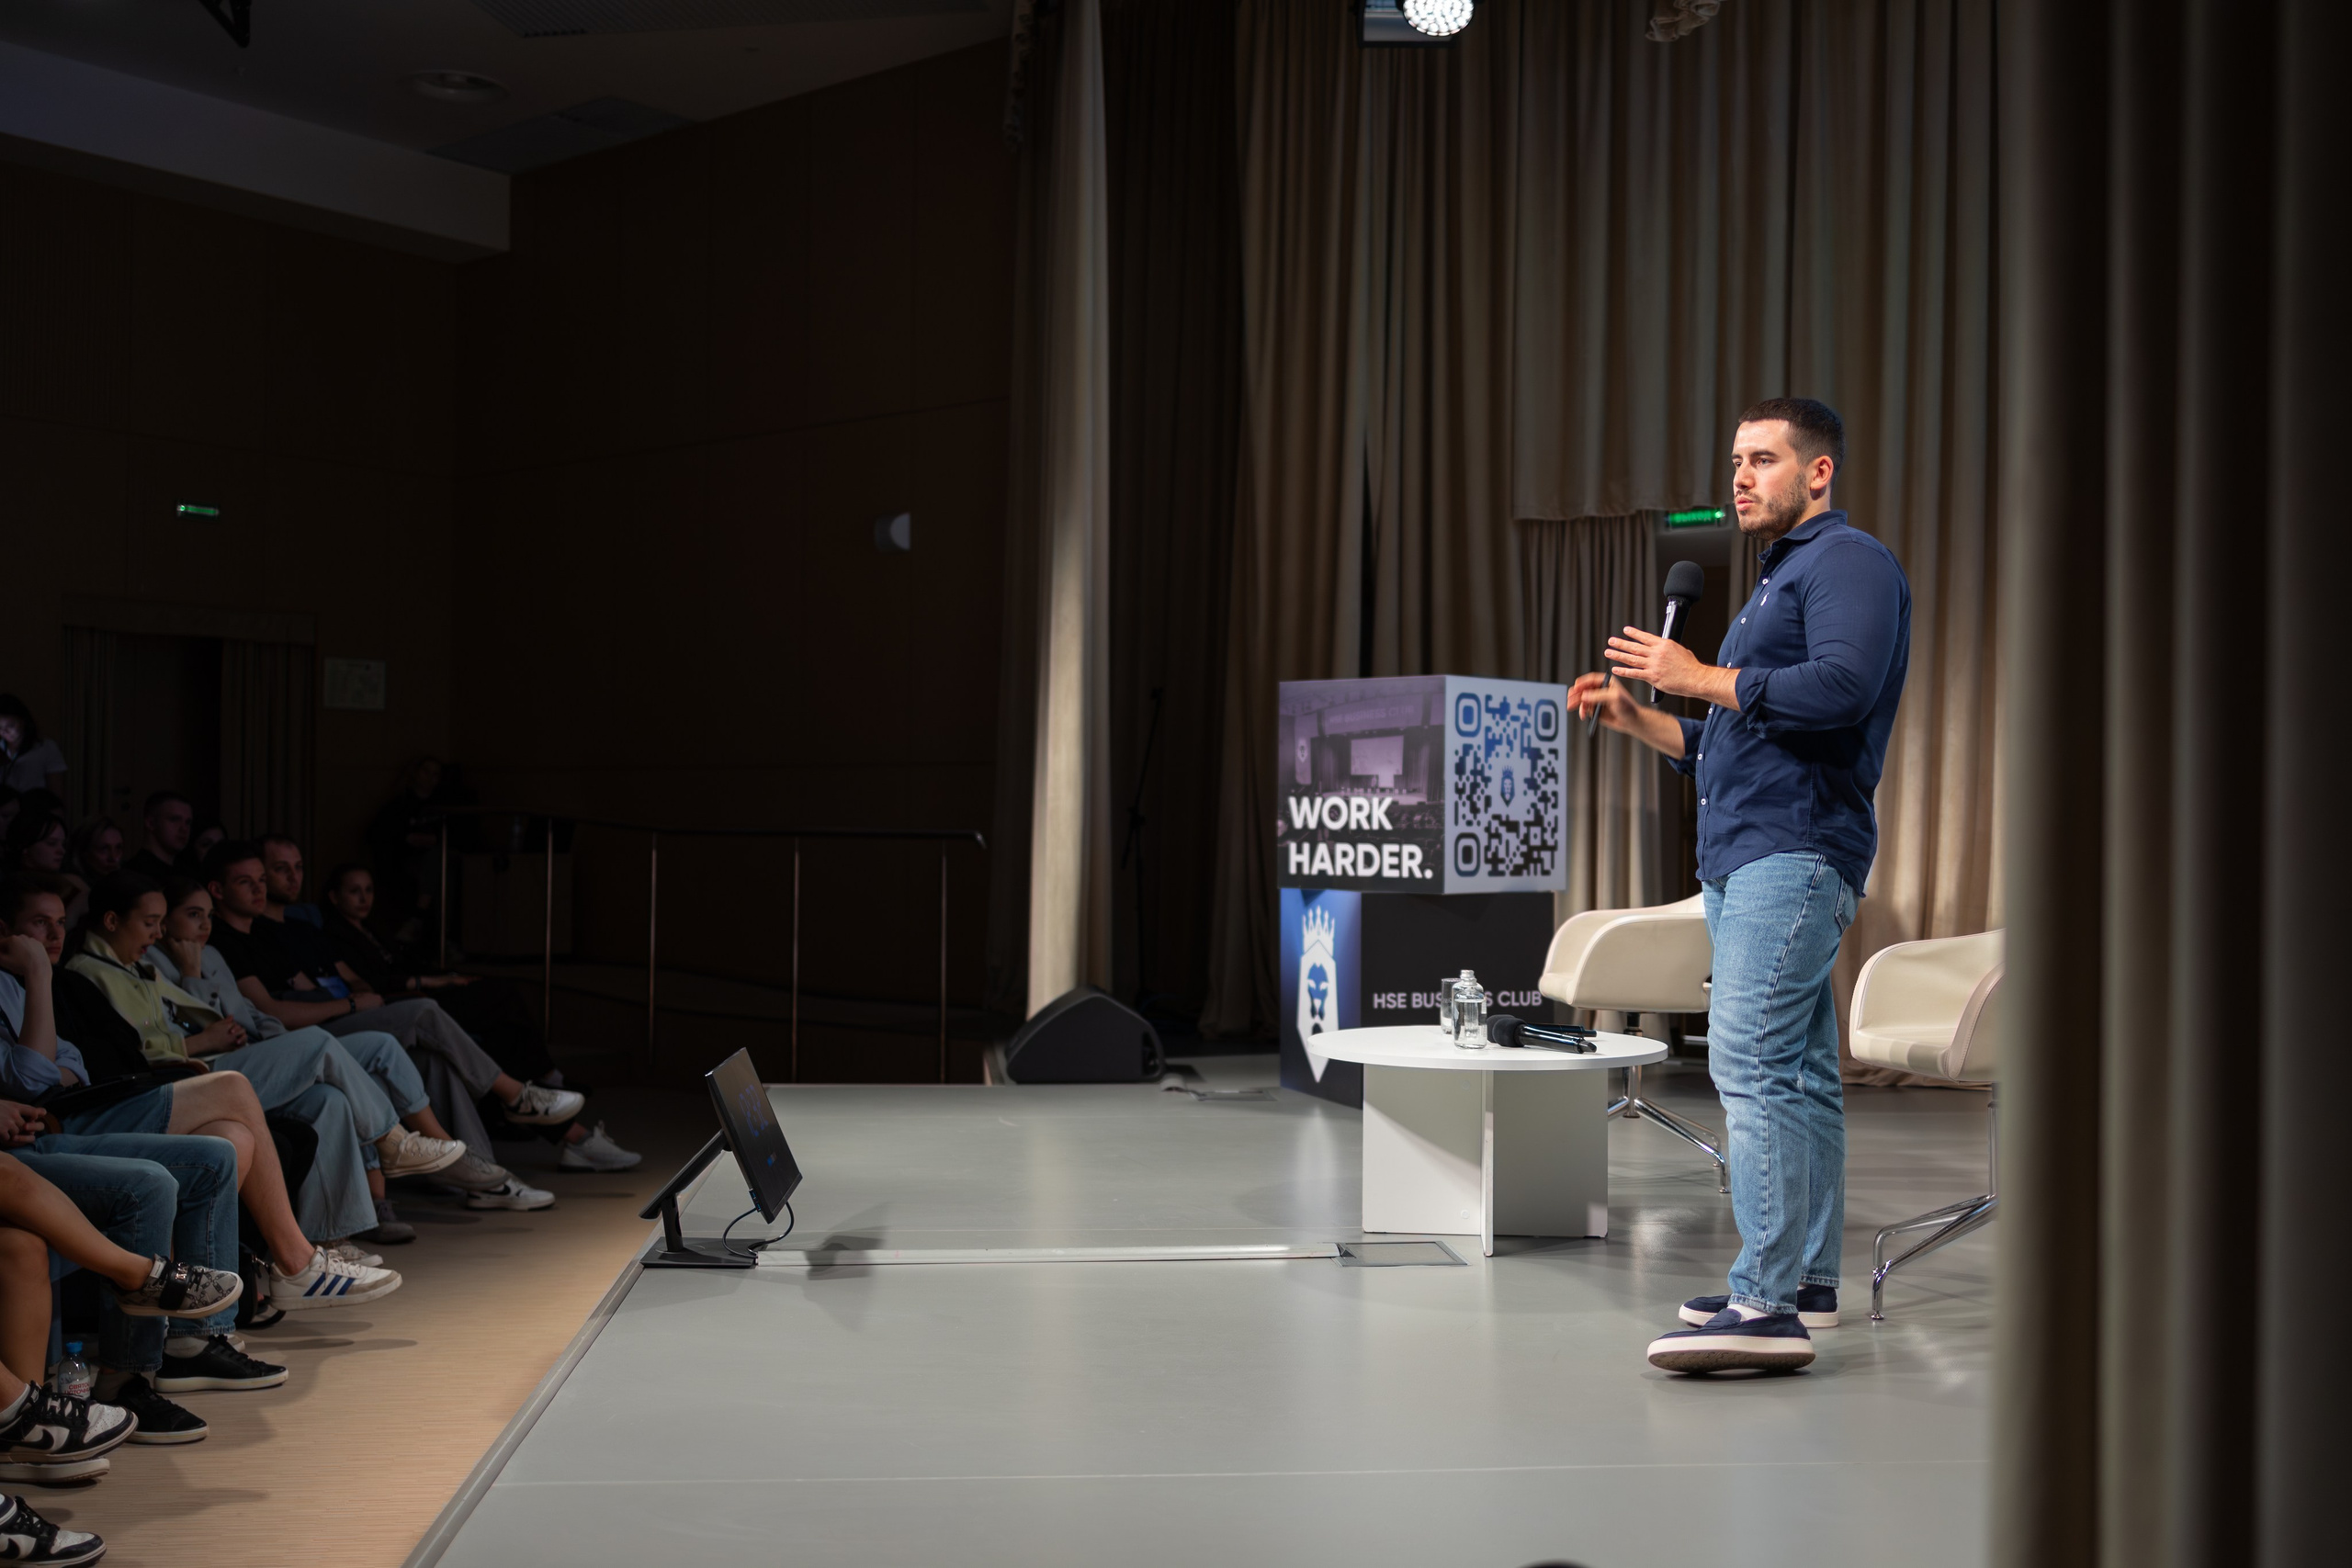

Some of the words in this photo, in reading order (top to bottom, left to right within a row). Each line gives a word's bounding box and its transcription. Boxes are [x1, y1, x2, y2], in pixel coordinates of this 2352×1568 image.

[1288, 796, 1394, 830] WORK
[1288, 842, 1433, 879] HARDER.
[1374, 992, 1408, 1010] HSE
[1412, 991, 1494, 1009] BUSS
[1498, 990, 1543, 1008] CLUB
